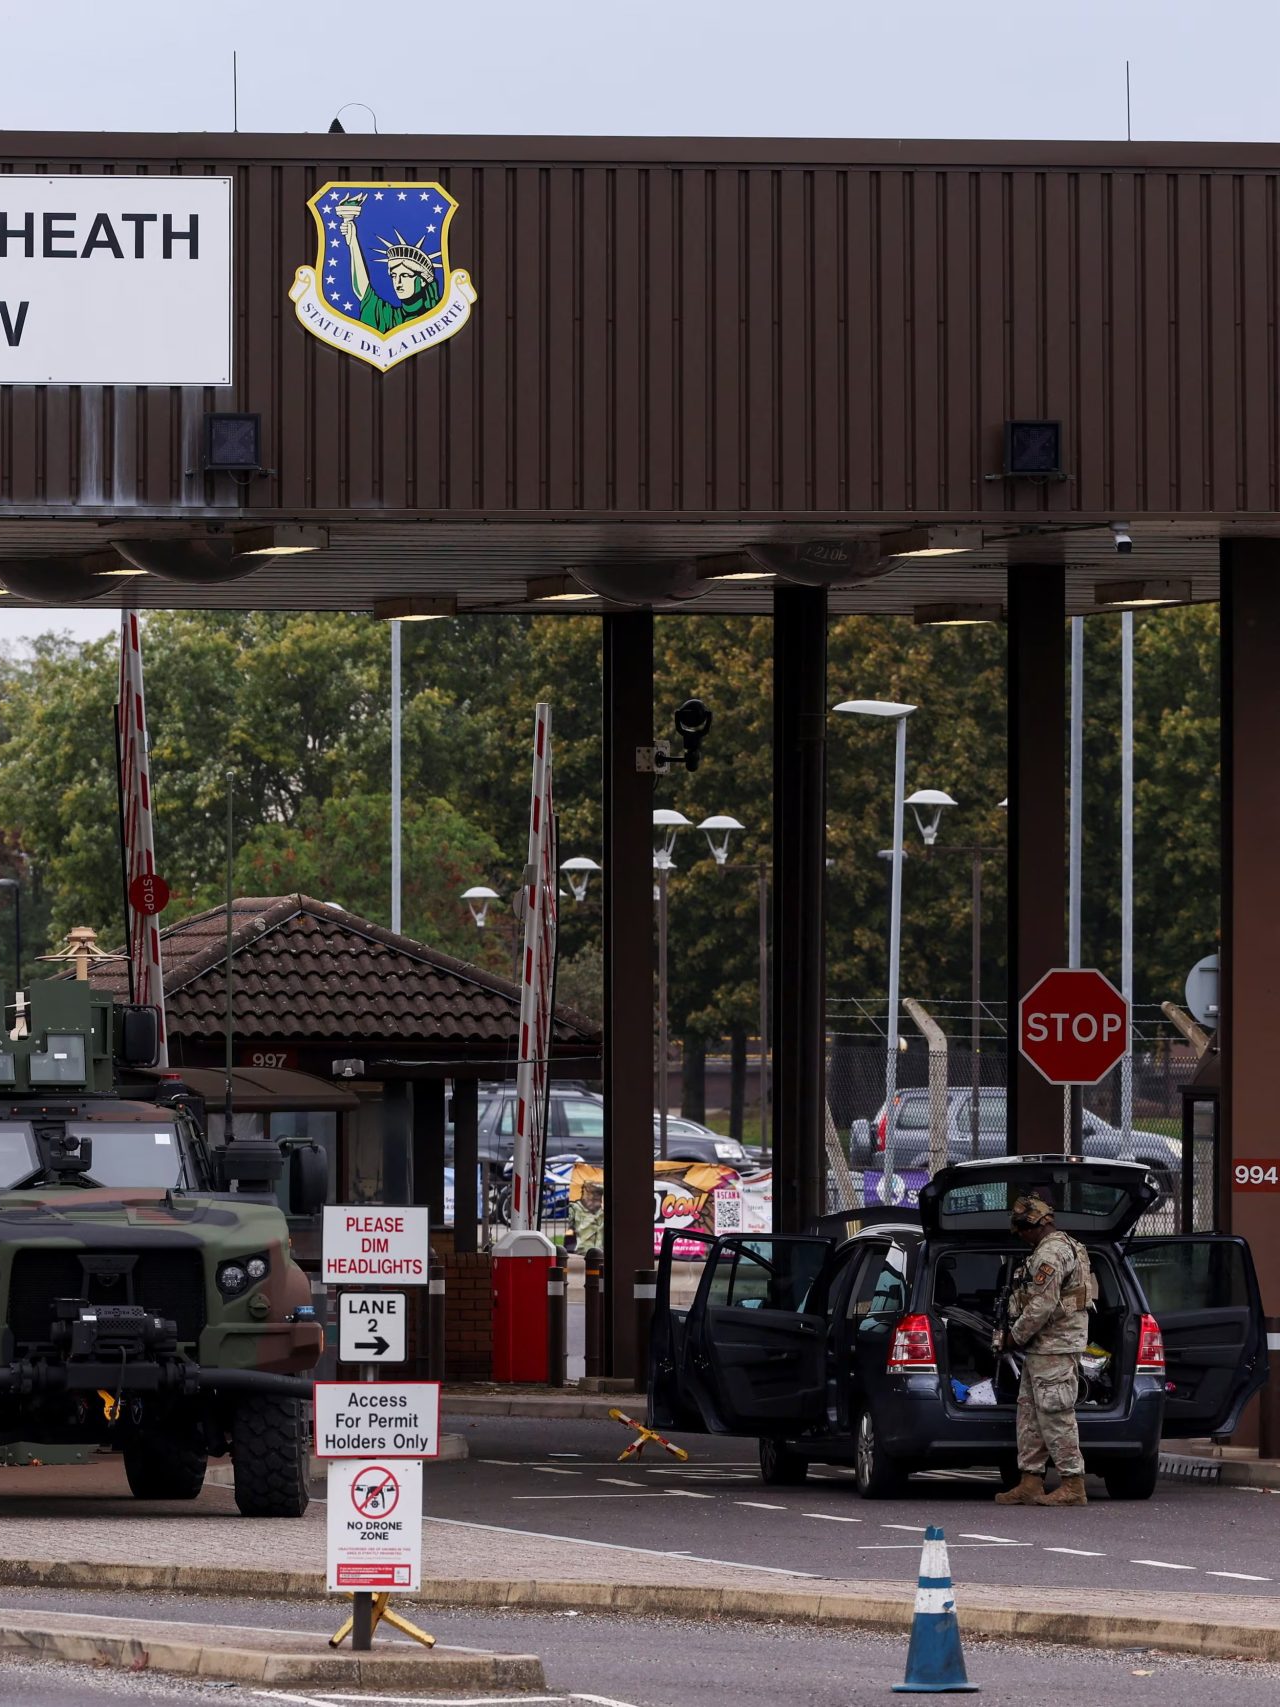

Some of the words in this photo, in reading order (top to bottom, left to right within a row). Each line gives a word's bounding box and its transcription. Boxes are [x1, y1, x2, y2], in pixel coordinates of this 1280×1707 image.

[302, 302, 354, 343] STATUE
[360, 339, 382, 357] DE
[387, 341, 409, 358] LA
[411, 300, 466, 345] LIBERTE
[143, 879, 154, 911] STOP
[1026, 1012, 1122, 1042] STOP
[252, 1053, 287, 1068] 997
[1234, 1165, 1278, 1184] 994
[720, 1191, 737, 1200] SCAN
[661, 1193, 707, 1219] CON!
[346, 1217, 404, 1232] PLEASE
[361, 1238, 389, 1253] DIM
[327, 1258, 423, 1275] HEADLIGHTS
[349, 1300, 397, 1315] LANE
[367, 1318, 379, 1333] 2
[348, 1393, 407, 1407] Access
[335, 1413, 362, 1428] For
[368, 1413, 419, 1428] Permit
[325, 1434, 386, 1449] Holders
[393, 1434, 428, 1452] Only
[347, 1522, 363, 1531] NO
[365, 1522, 403, 1531] DRONE
[360, 1532, 389, 1541] ZONE
